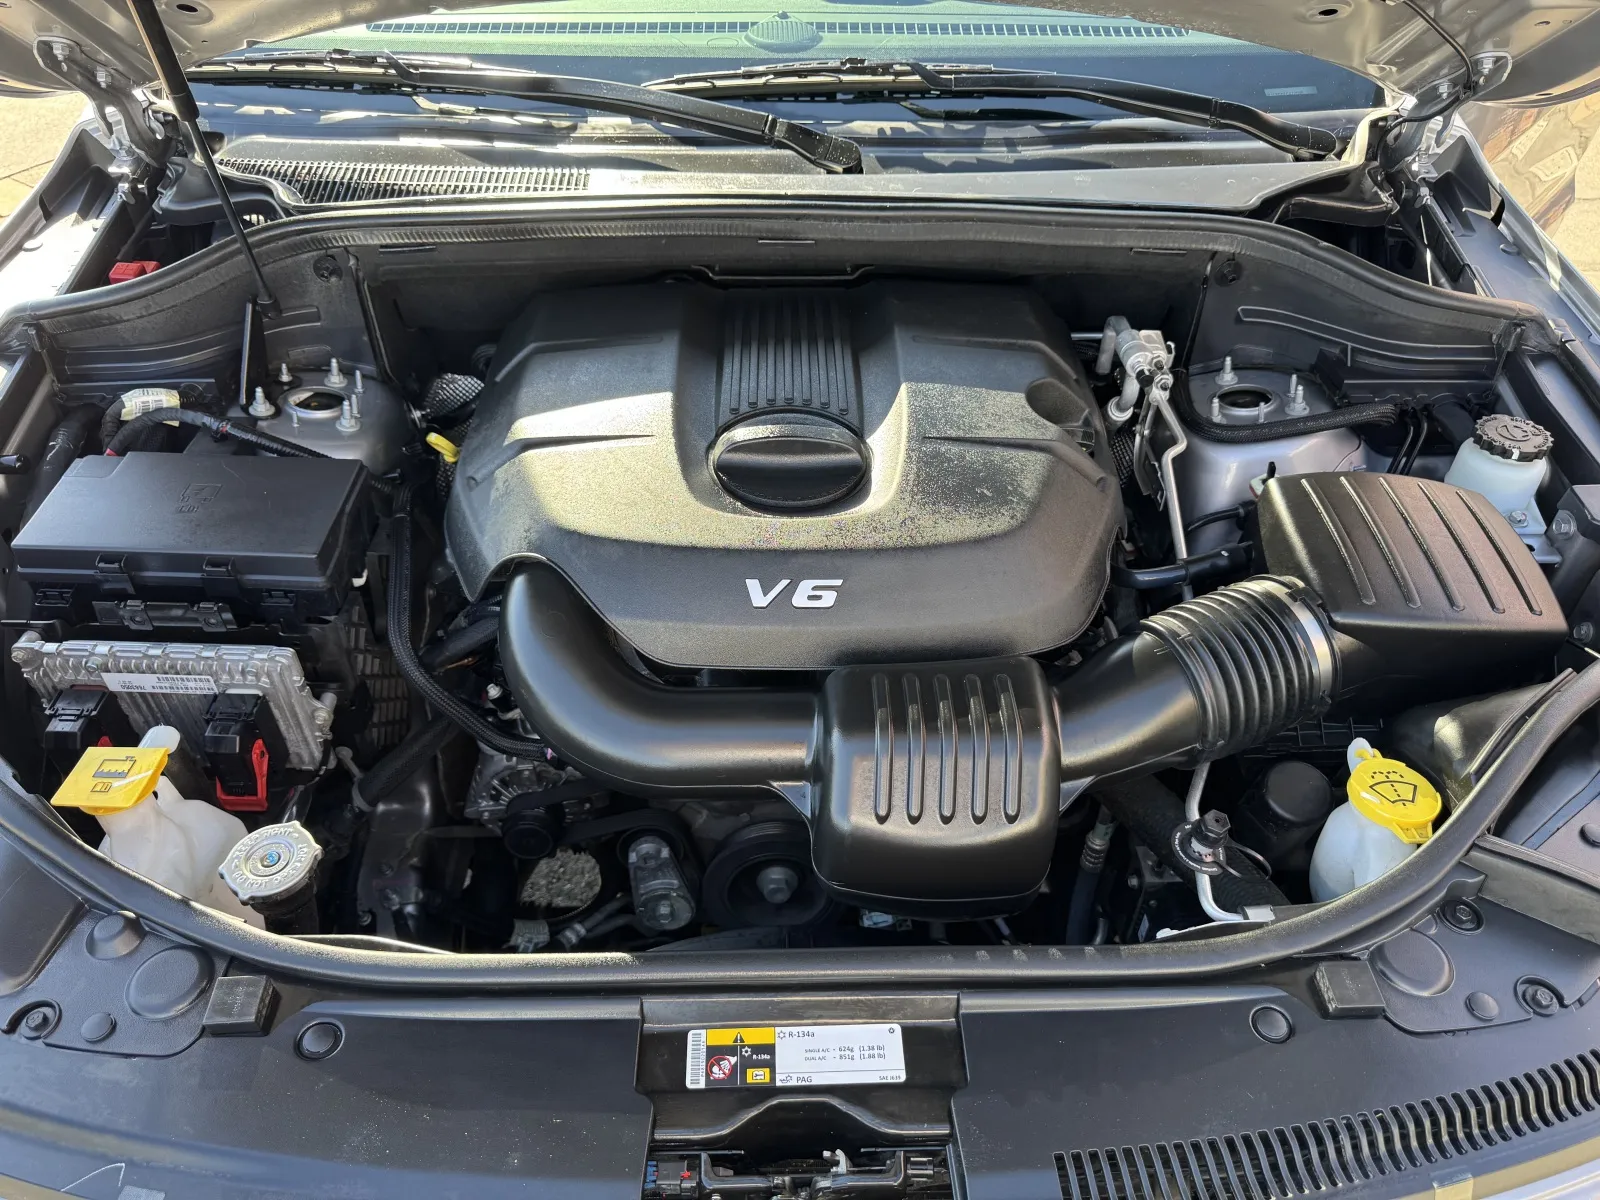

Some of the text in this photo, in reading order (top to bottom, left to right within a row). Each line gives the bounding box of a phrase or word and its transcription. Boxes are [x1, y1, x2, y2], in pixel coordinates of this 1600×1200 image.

[745, 579, 843, 608] V6
[233, 834, 260, 858] KEEP
[233, 870, 246, 882] DO
[245, 879, 269, 888] NOT
[788, 1030, 815, 1038] R-134a
[838, 1045, 855, 1053] 624g
[859, 1044, 876, 1053] (1.38
[876, 1044, 885, 1052] lb)
[838, 1053, 855, 1061] 851g
[876, 1052, 886, 1060] lb)
[796, 1075, 813, 1083] PAG
